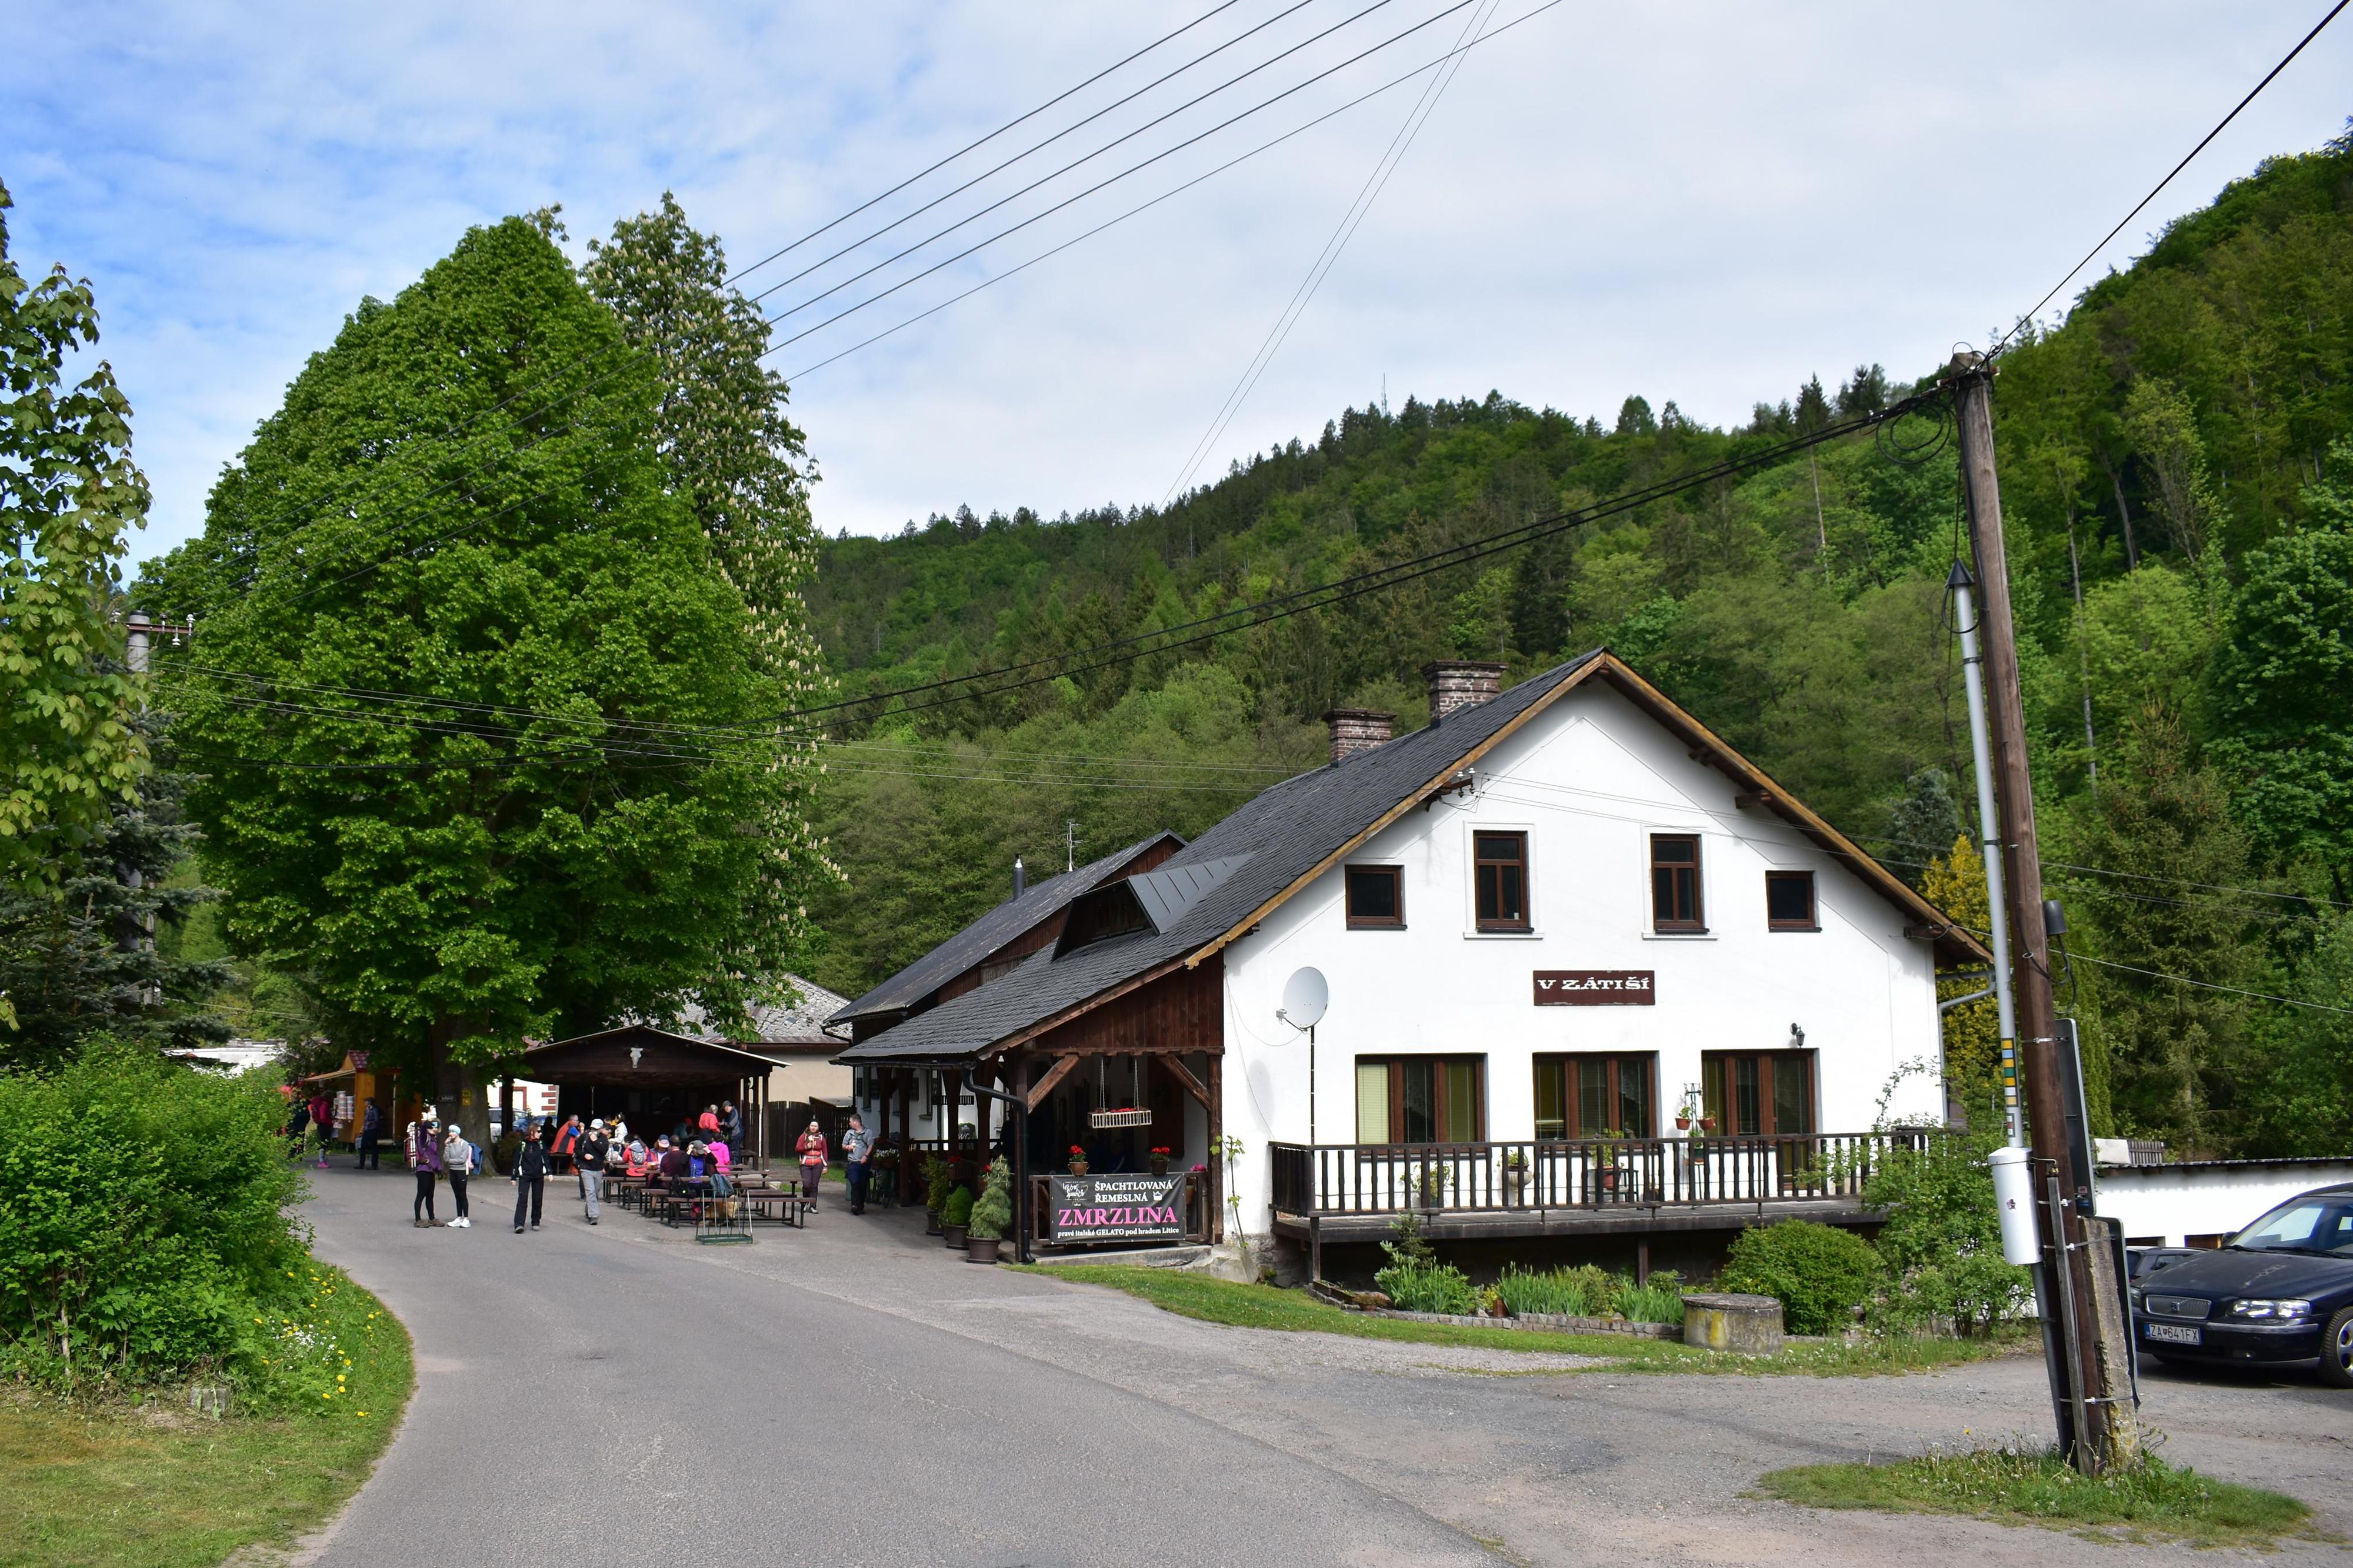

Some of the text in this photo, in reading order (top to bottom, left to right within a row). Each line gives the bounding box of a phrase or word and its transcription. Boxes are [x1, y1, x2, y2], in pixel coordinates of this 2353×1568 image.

[1537, 977, 1649, 990] V ZÁTIŠÍ
[1095, 1180, 1172, 1191] ŠPACHTLOVANÁ
[1095, 1192, 1148, 1203] ŘEMESLNÁ
[1058, 1206, 1178, 1226] ZMRZLINA
[1125, 1228, 1137, 1236] pod
